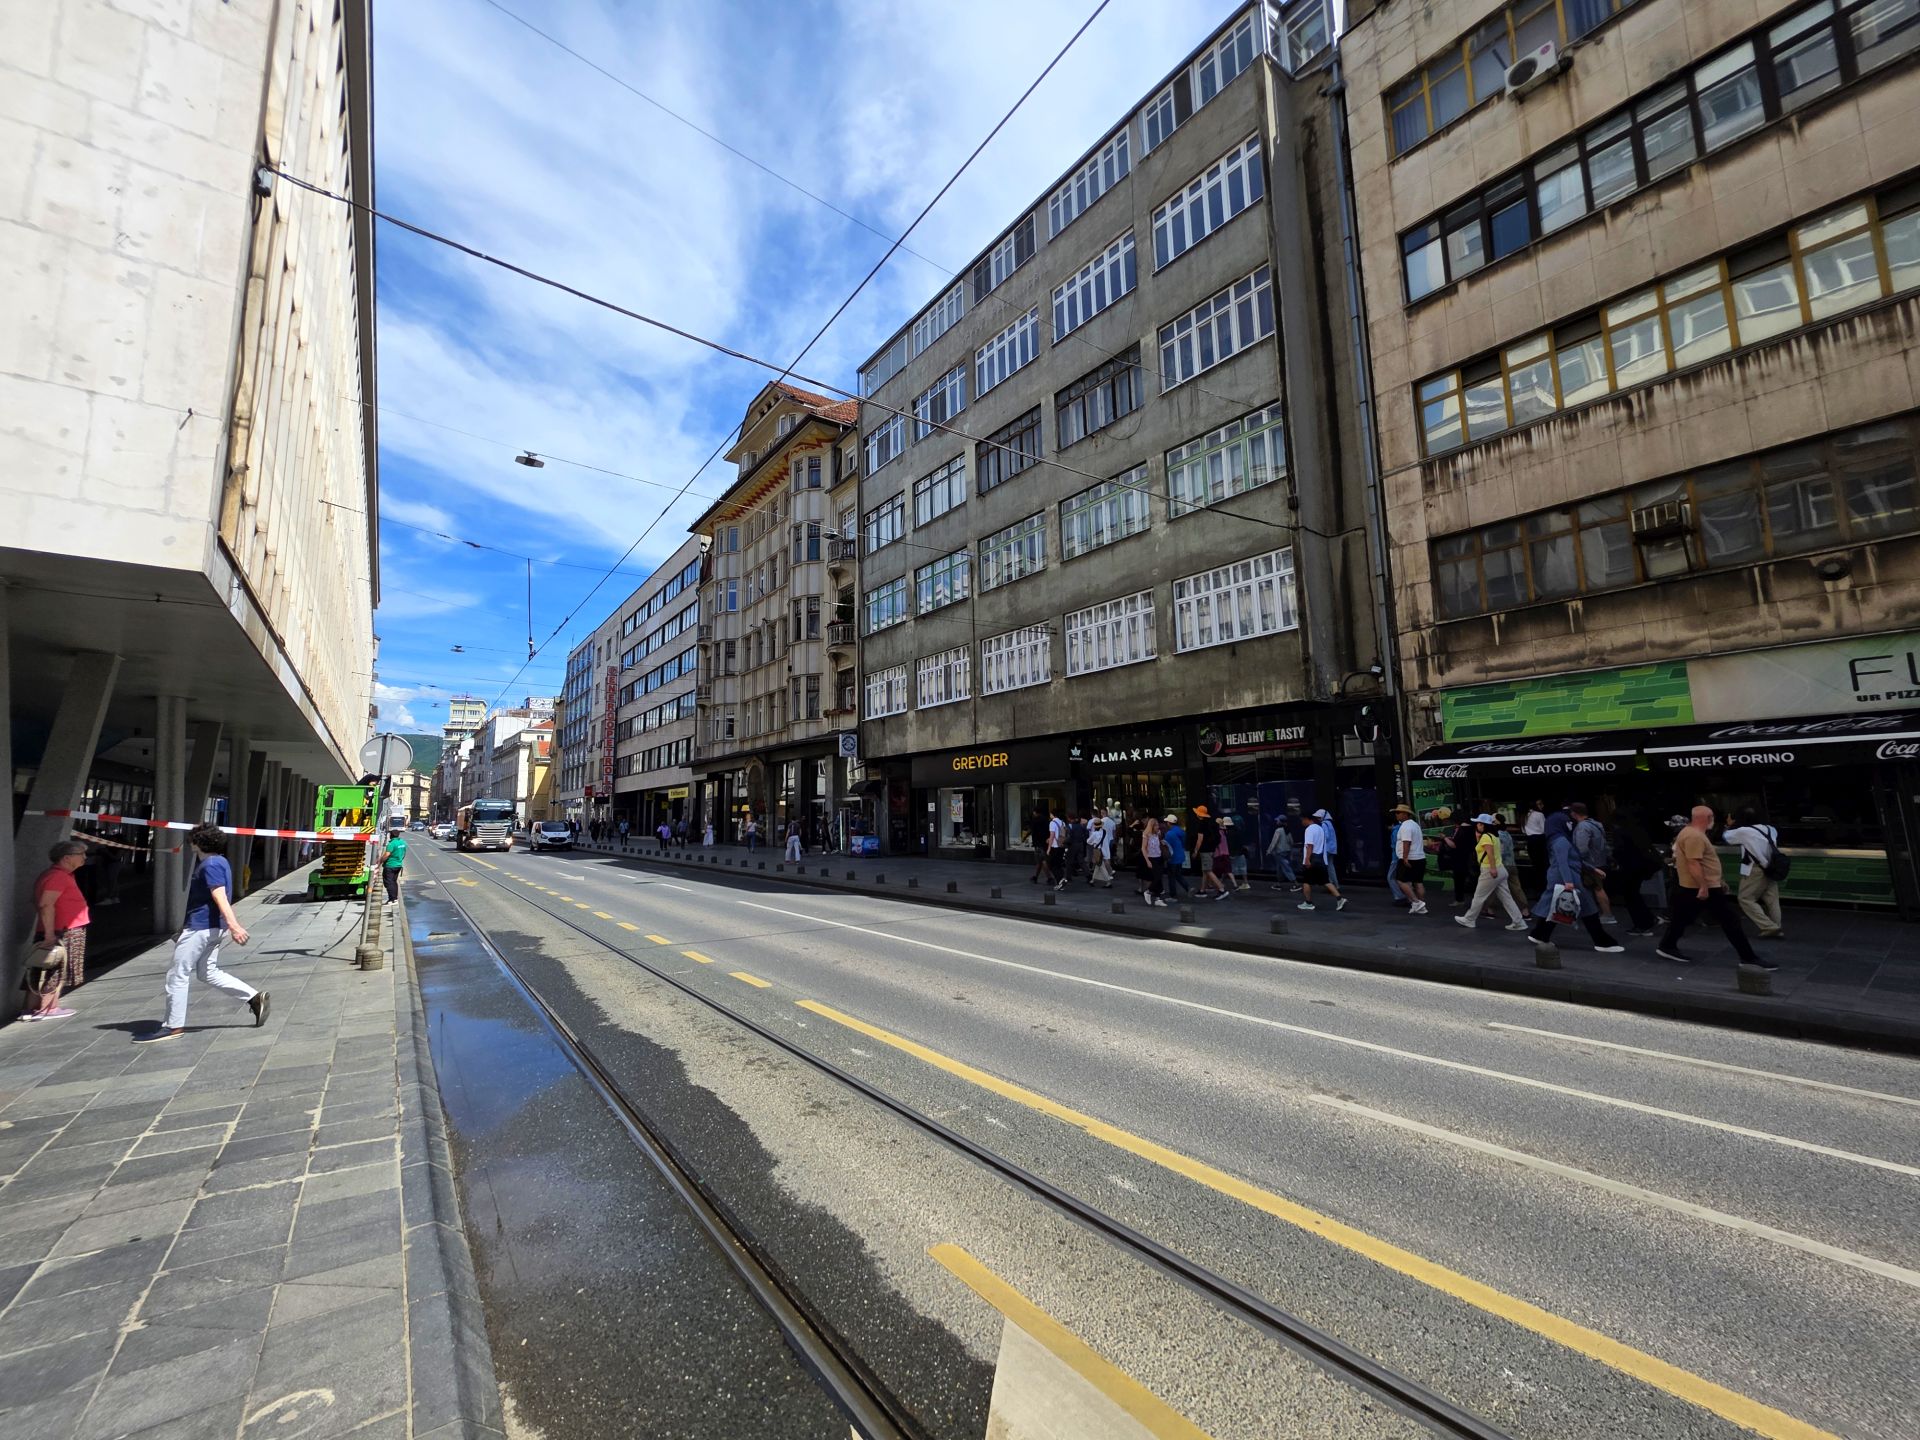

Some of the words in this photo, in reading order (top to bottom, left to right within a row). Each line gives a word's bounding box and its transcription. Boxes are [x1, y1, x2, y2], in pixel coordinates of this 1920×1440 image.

[1856, 694, 1881, 702] UR
[604, 676, 616, 785] ENERGOPETROL
[1226, 729, 1266, 746] HEALTHY
[1275, 725, 1306, 741] TASTY
[952, 752, 1009, 771] GREYDER
[1092, 751, 1128, 764] ALMA
[1144, 746, 1174, 760] RAS
[1668, 755, 1724, 768] BUREK
[1728, 751, 1795, 765] FORINO
[1512, 763, 1562, 775] GELATO
[1565, 761, 1617, 773] FORINO
